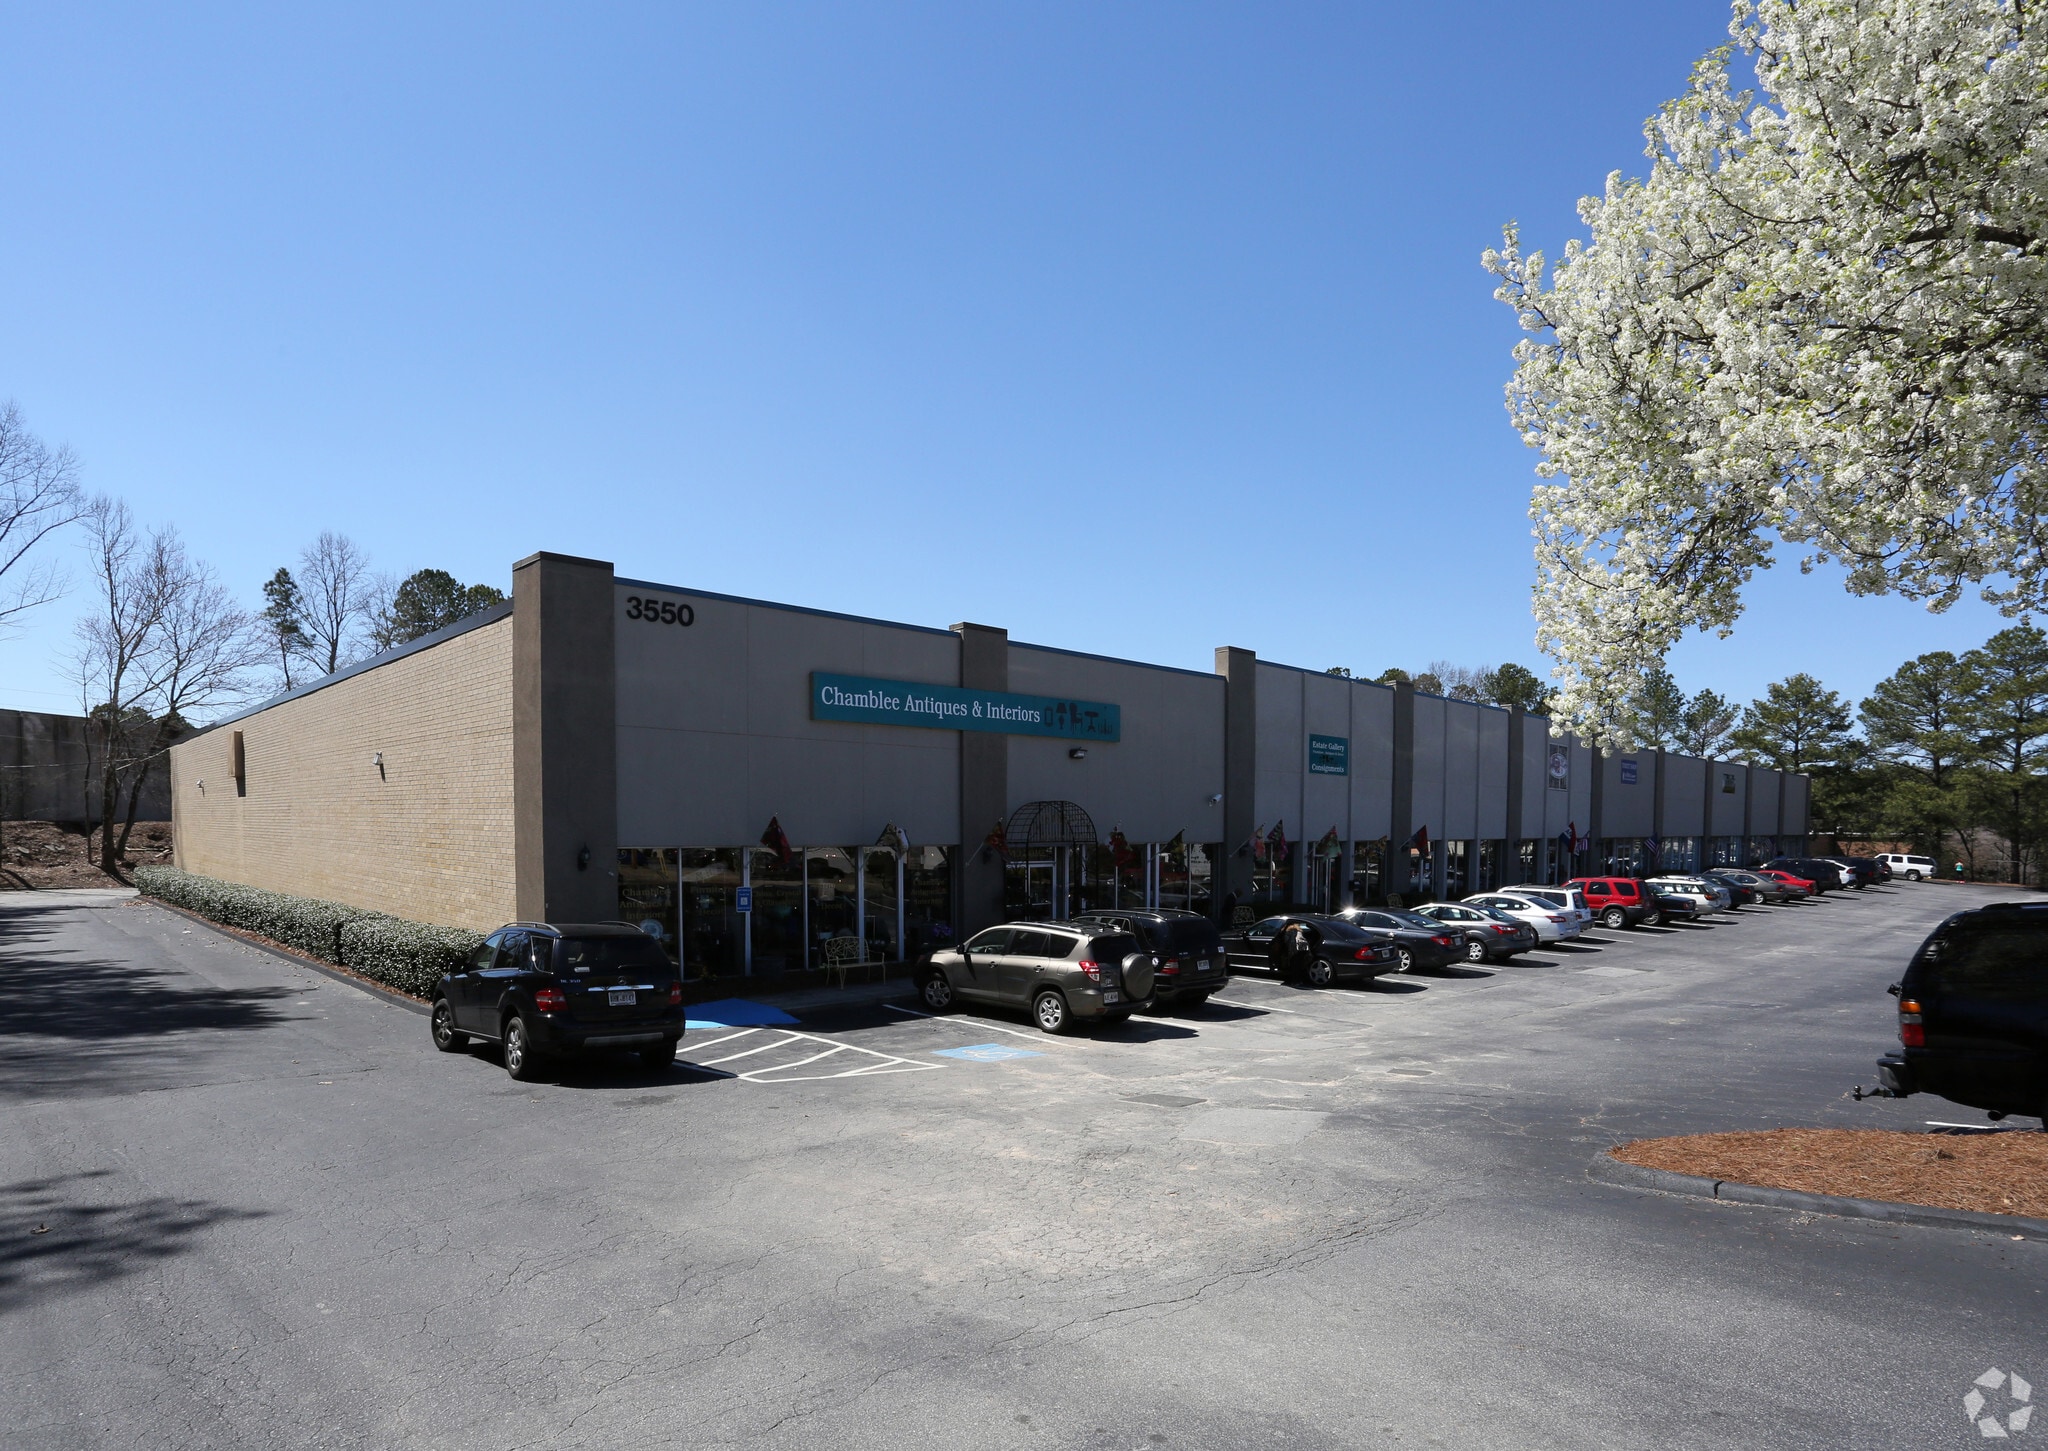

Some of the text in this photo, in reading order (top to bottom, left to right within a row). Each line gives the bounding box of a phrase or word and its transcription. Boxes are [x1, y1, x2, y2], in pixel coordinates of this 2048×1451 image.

[626, 595, 694, 627] 3550
[821, 685, 1042, 723] Chamblee Antiques & Interiors
[1312, 741, 1345, 753] Estate Gallery
